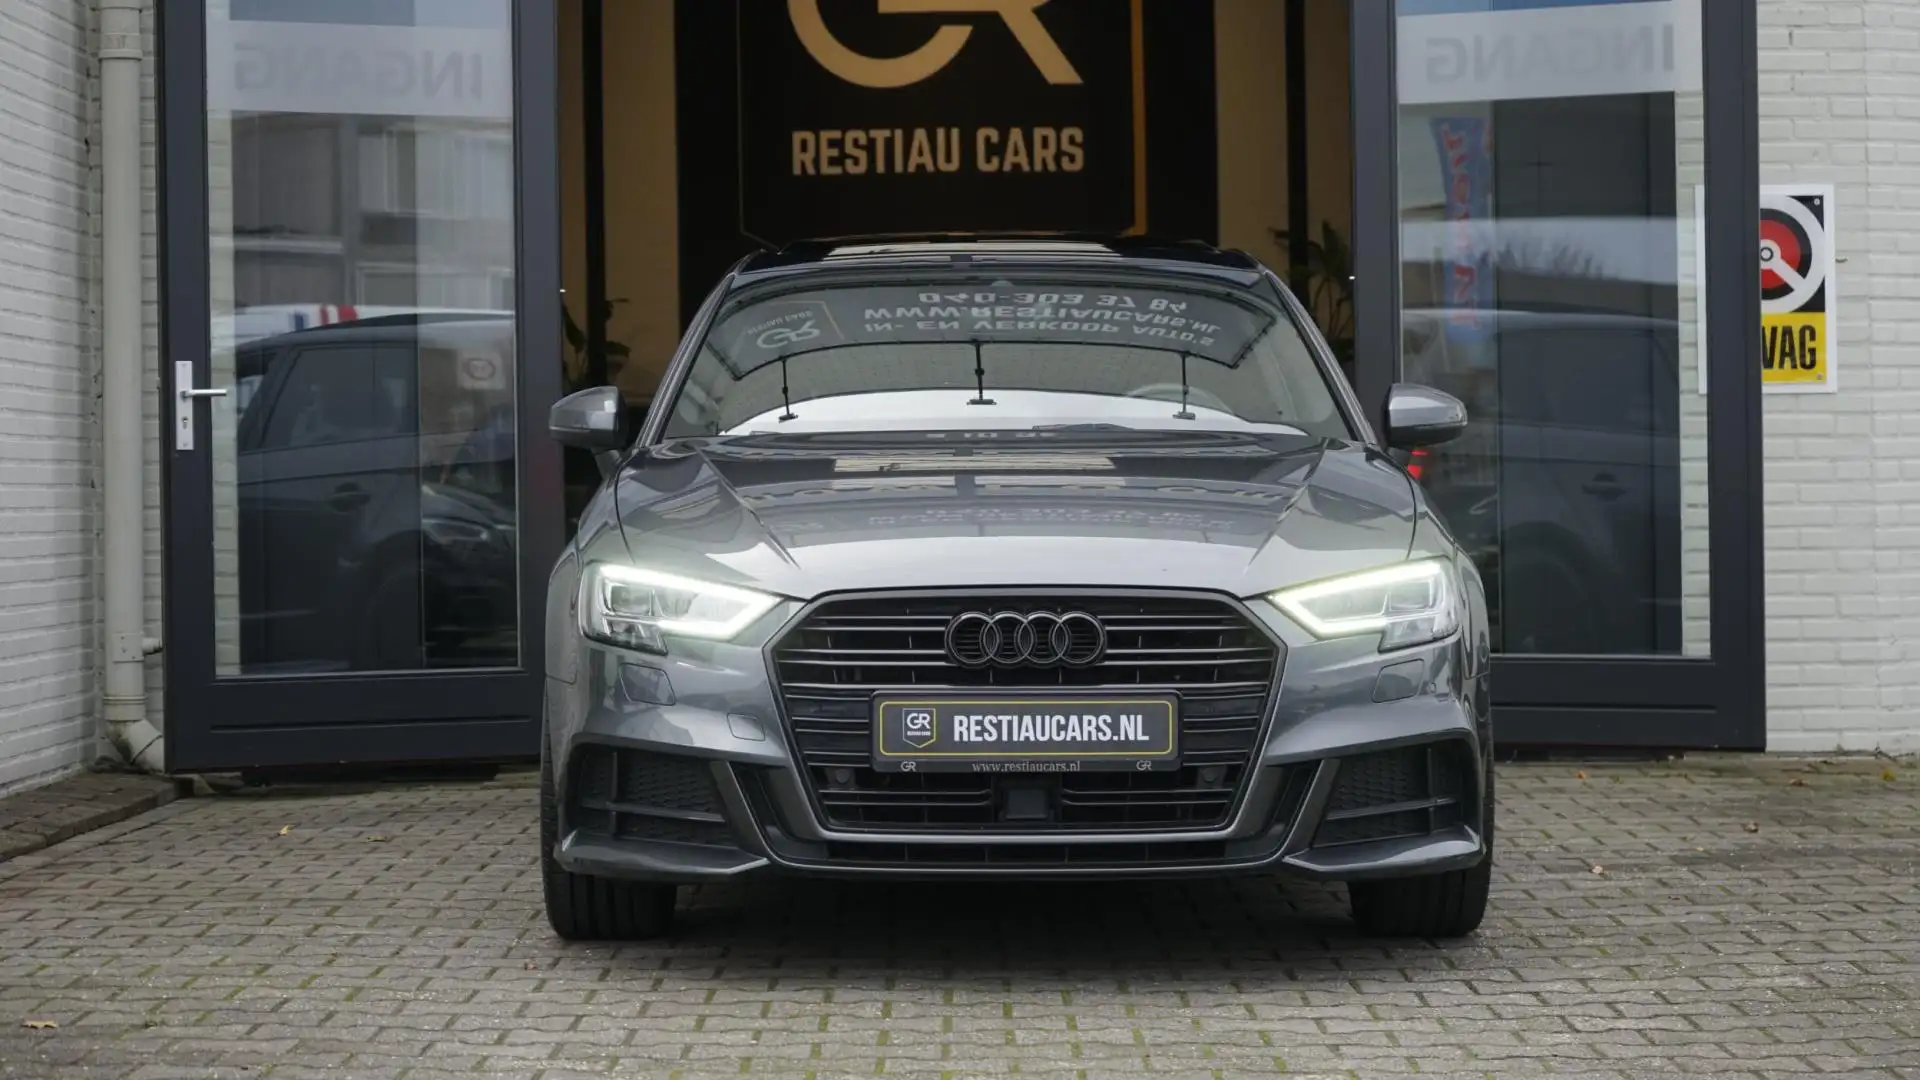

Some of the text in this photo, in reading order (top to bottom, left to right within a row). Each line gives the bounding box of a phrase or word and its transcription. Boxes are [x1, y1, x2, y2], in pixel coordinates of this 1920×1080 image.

[792, 126, 1084, 176] RESTIAU CARS
[1761, 324, 1817, 371] VAG
[906, 712, 931, 730] GR
[953, 714, 1150, 742] RESTIAUCARS.NL
[900, 760, 917, 773] GR
[971, 760, 1081, 773] www.restiaucars.nl
